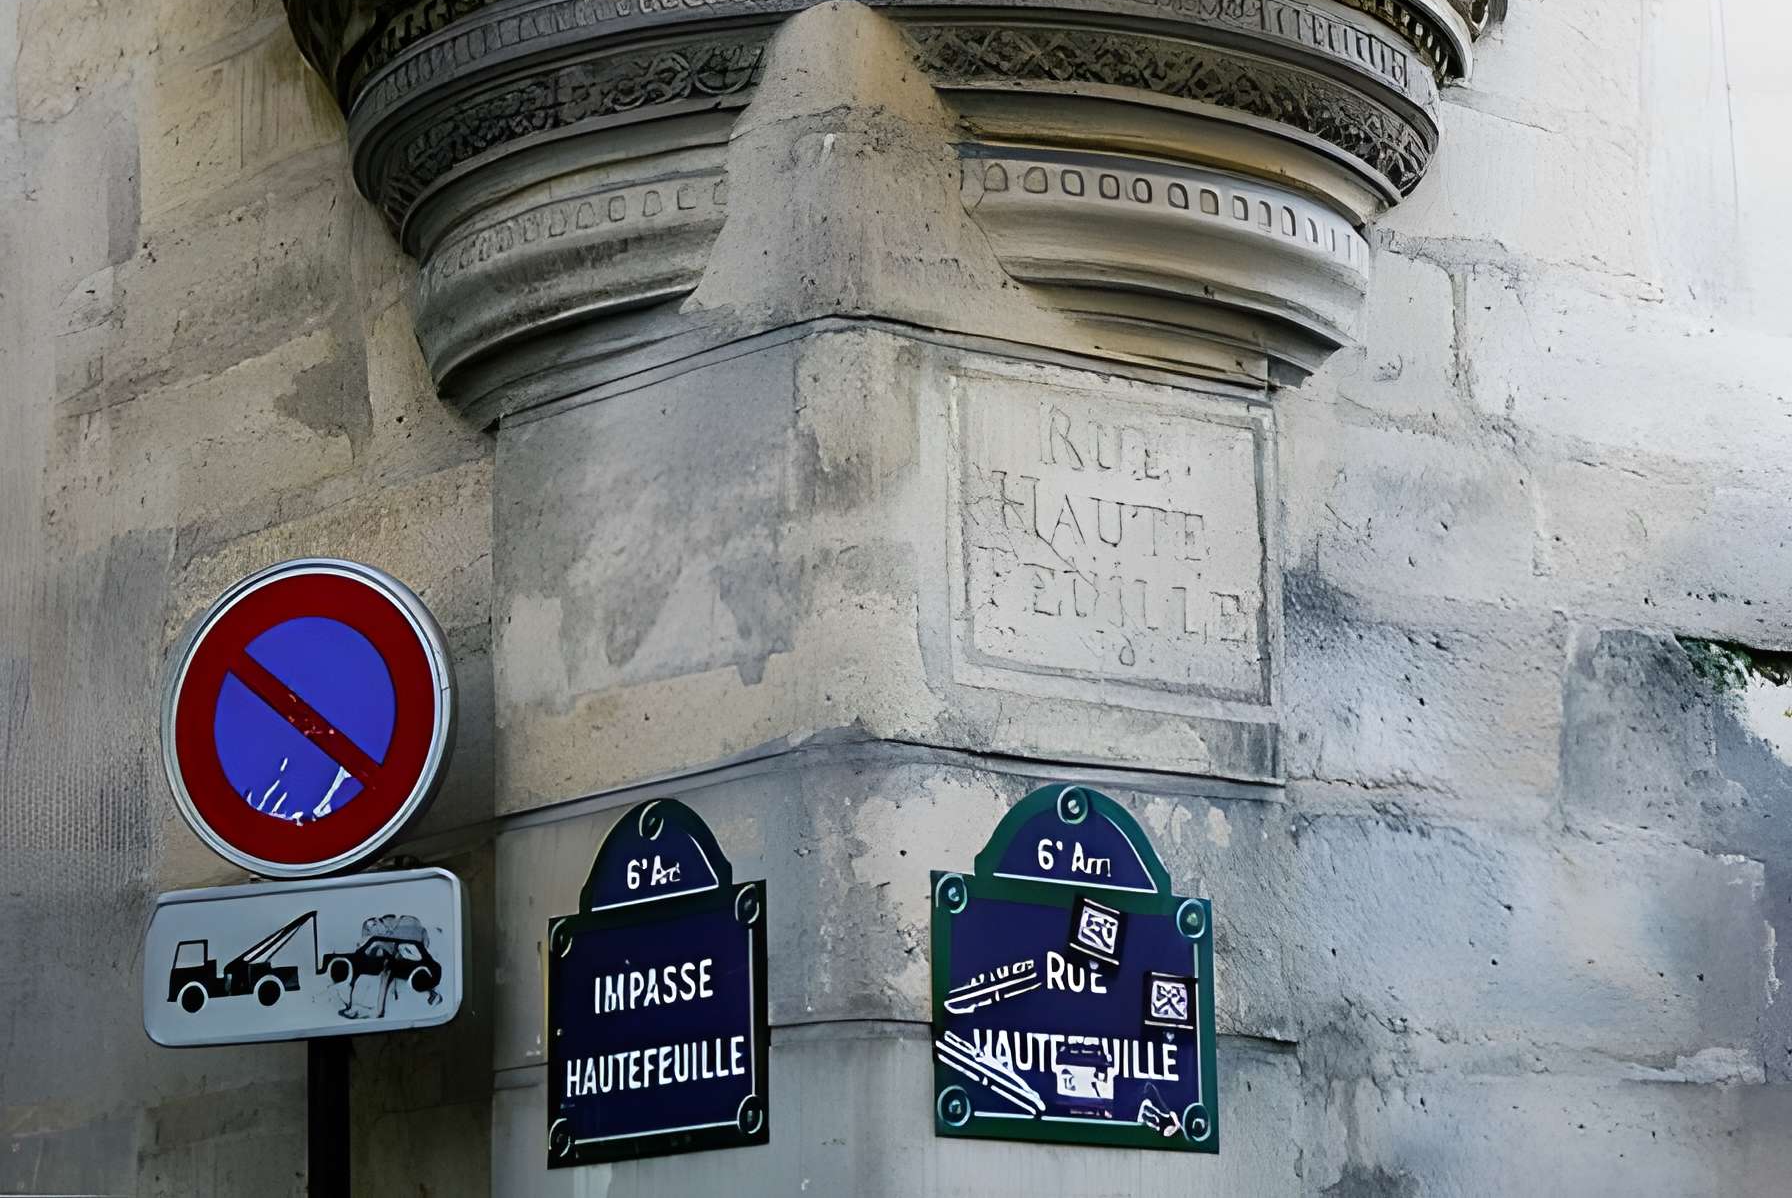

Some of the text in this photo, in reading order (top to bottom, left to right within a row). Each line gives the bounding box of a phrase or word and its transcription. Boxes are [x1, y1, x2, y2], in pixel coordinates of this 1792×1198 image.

[594, 958, 714, 1015] IMPASSE
[1046, 951, 1108, 995] RUE
[566, 1035, 746, 1099] HAUTEFEUILLE
